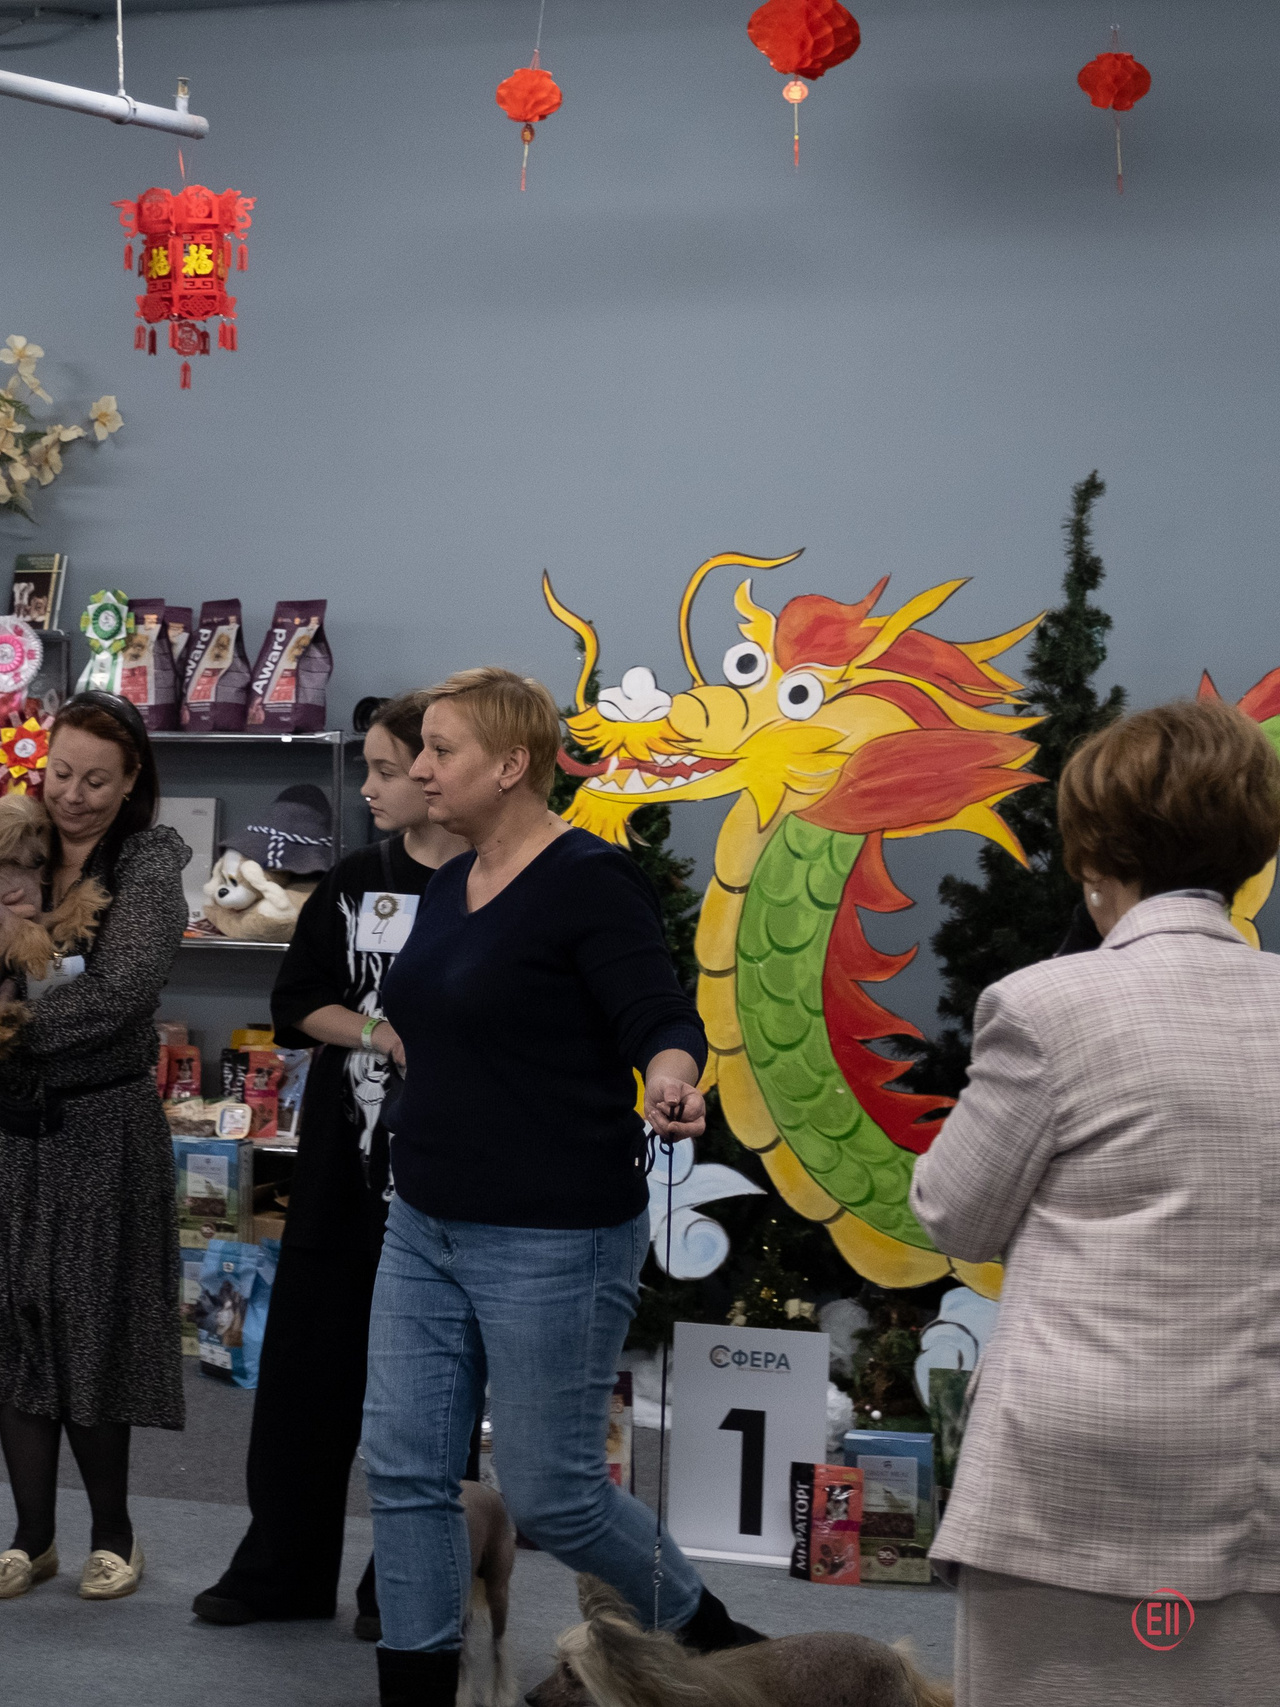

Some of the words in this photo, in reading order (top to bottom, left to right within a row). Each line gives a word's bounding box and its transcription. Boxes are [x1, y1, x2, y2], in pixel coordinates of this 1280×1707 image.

[185, 628, 212, 677] ward
[252, 628, 287, 695] Award
[709, 1344, 791, 1370] СФЕРА
[718, 1408, 766, 1536] 1
